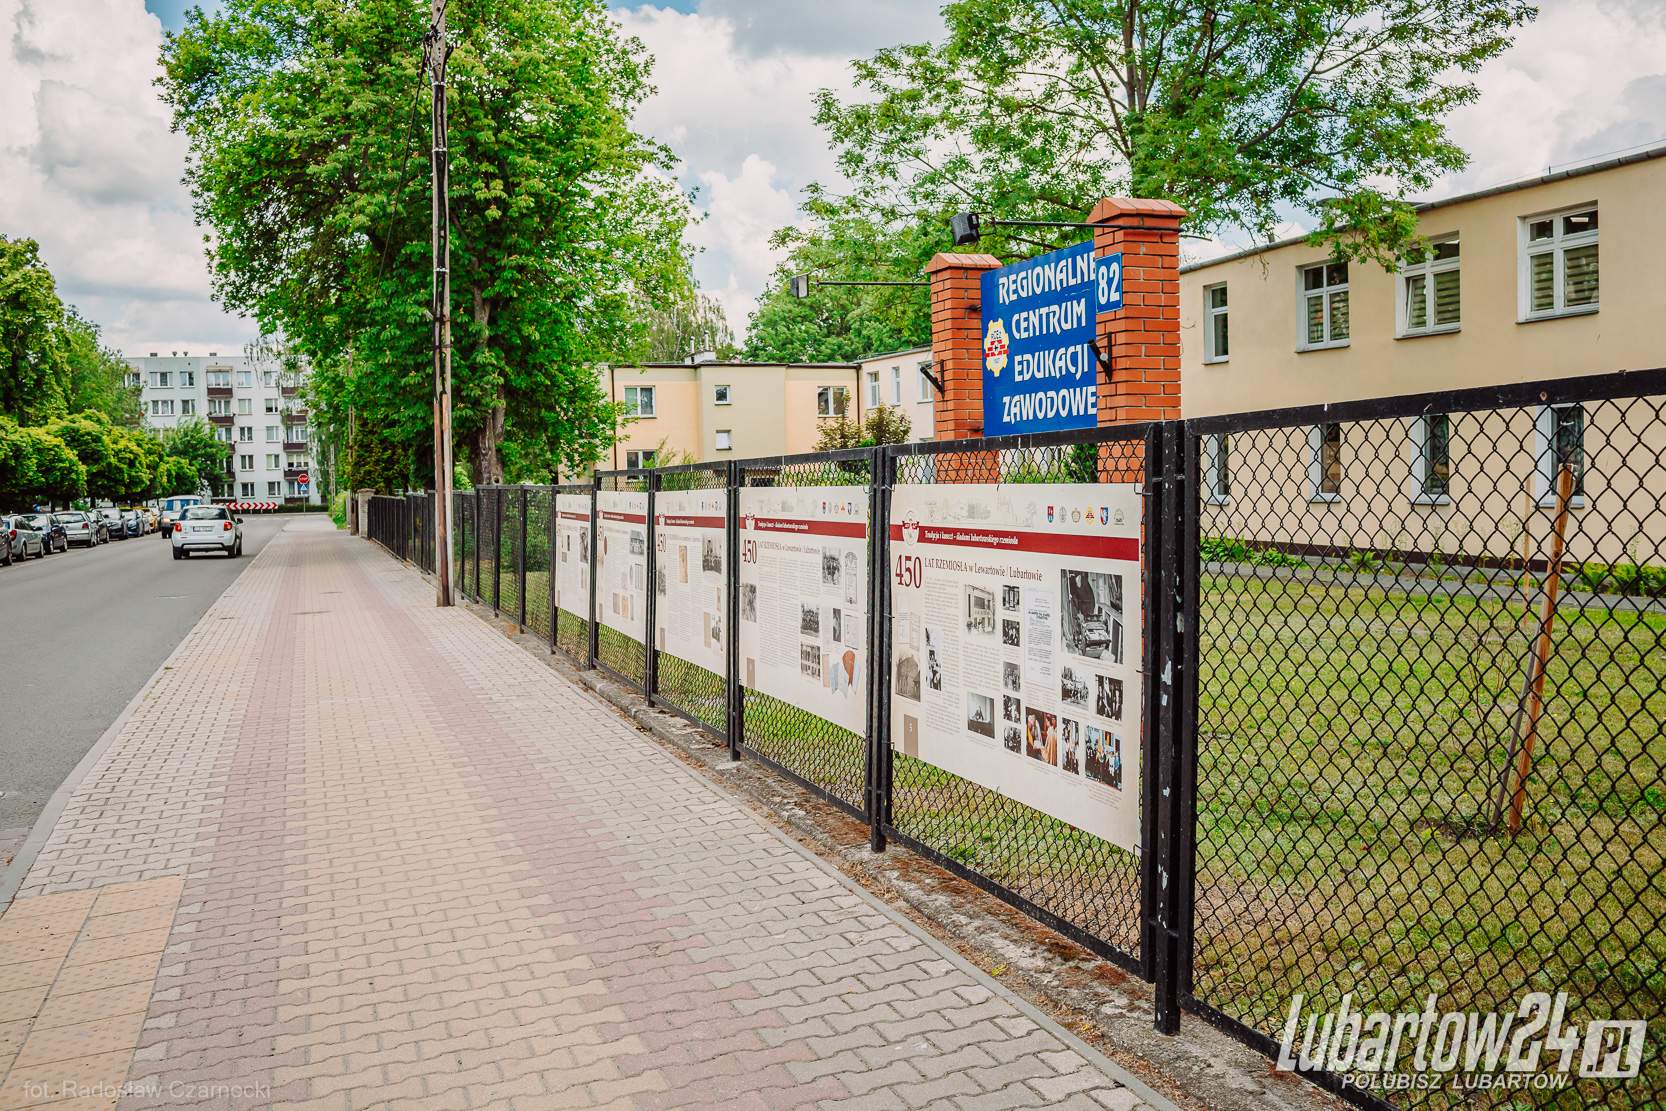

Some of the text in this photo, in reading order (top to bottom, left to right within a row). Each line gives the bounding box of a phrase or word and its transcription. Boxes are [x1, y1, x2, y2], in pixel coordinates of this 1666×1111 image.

[999, 251, 1096, 305] REGIONALNE
[1098, 262, 1120, 305] 82
[1011, 298, 1086, 340] CENTRUM
[1014, 343, 1088, 382] EDUKACJI
[742, 539, 757, 564] 450
[895, 554, 922, 588] 450
[1009, 566, 1042, 581] Lubartowie
